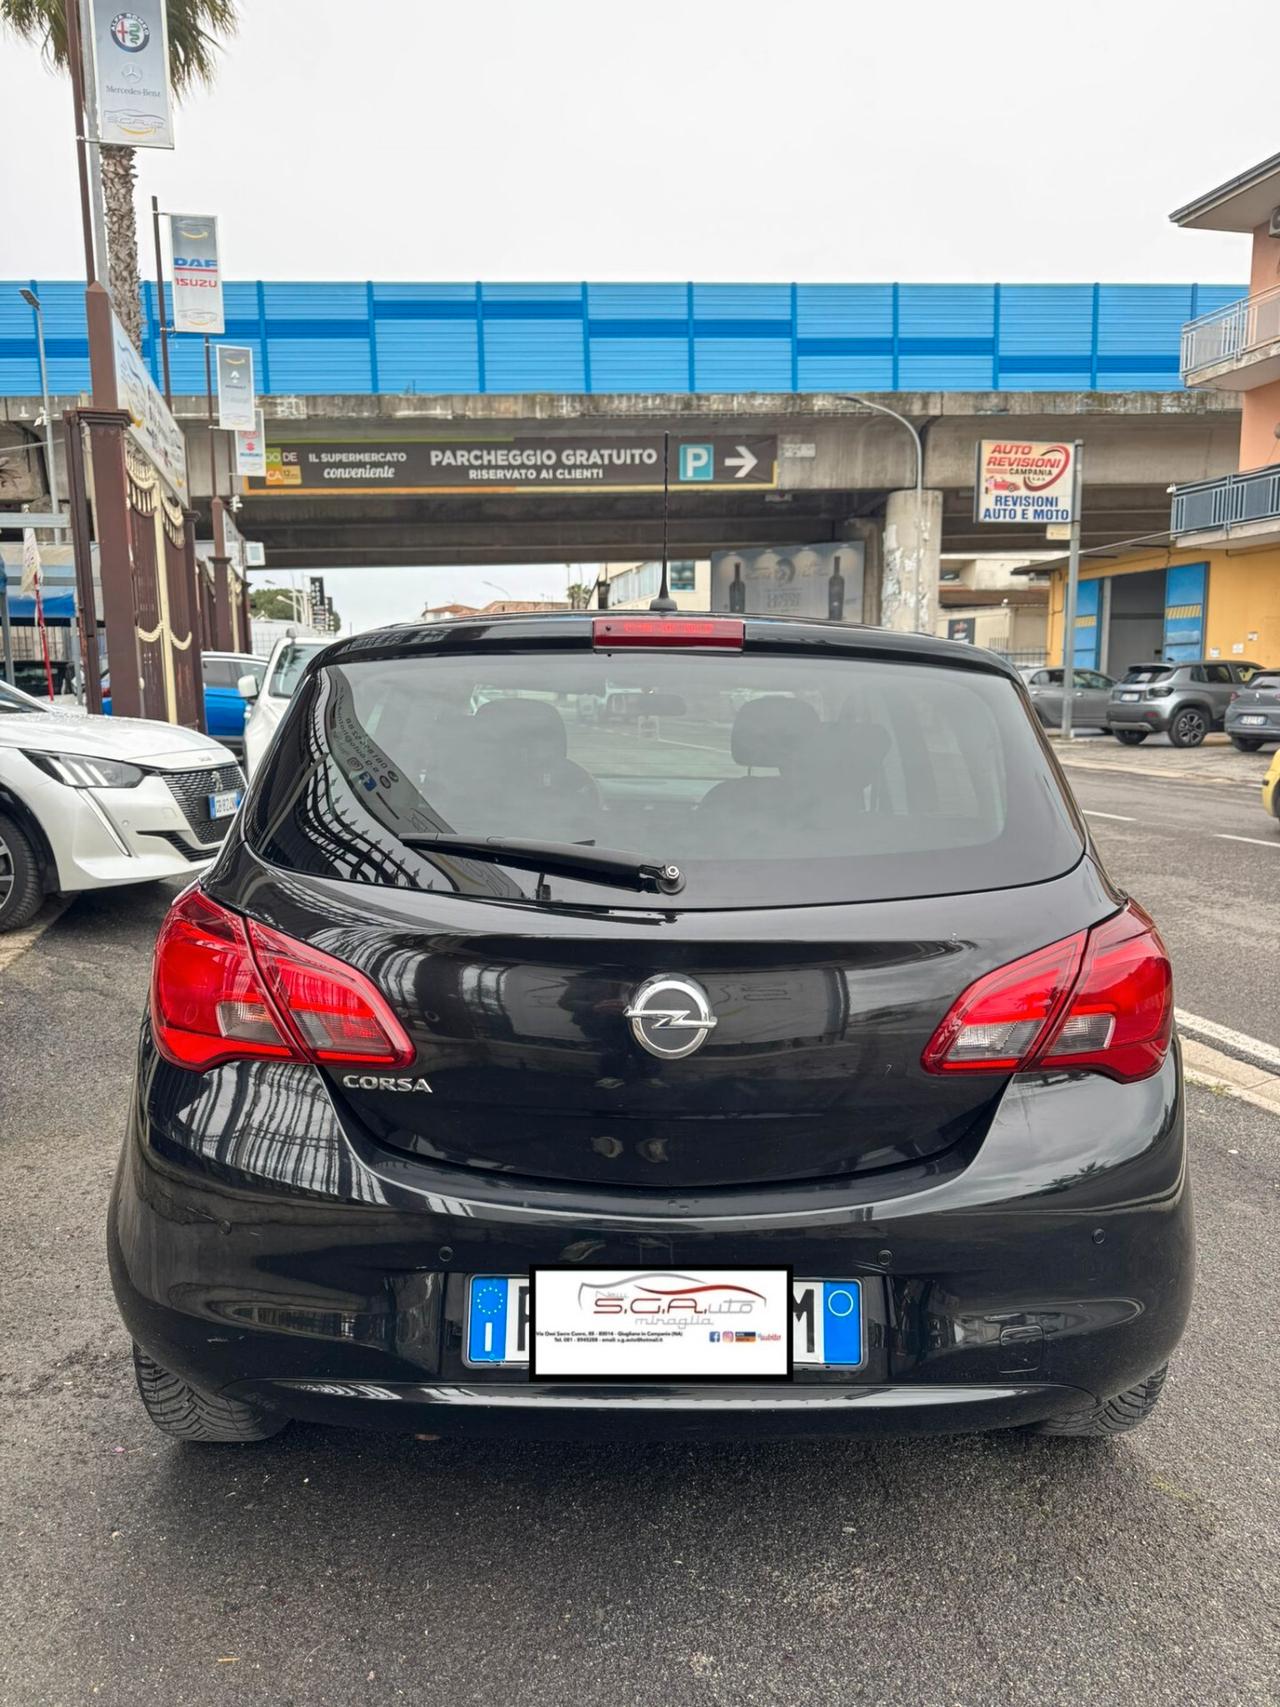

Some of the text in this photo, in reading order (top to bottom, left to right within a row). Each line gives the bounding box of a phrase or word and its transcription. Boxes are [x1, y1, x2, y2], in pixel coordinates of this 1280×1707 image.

[106, 85, 160, 97] Mercedes-Benz
[174, 257, 218, 268] DAF
[176, 278, 218, 288] ISUZU
[991, 444, 1033, 456] AUTO
[283, 452, 298, 462] DE
[308, 452, 407, 462] IL SUPERMERCATO
[430, 449, 556, 466] PARCHEGGIO
[561, 449, 657, 465] GRATUITO
[986, 456, 1062, 469] REVISIONI
[323, 465, 395, 479] conveniente
[469, 468, 603, 480] RISERVATO AI CLIENTI
[1009, 468, 1053, 476] CAMPANIA
[994, 495, 1059, 508] REVISIONI
[983, 508, 1069, 520] AUTO E MOTO
[343, 1074, 433, 1093] CORSA
[484, 1322, 493, 1352] I
